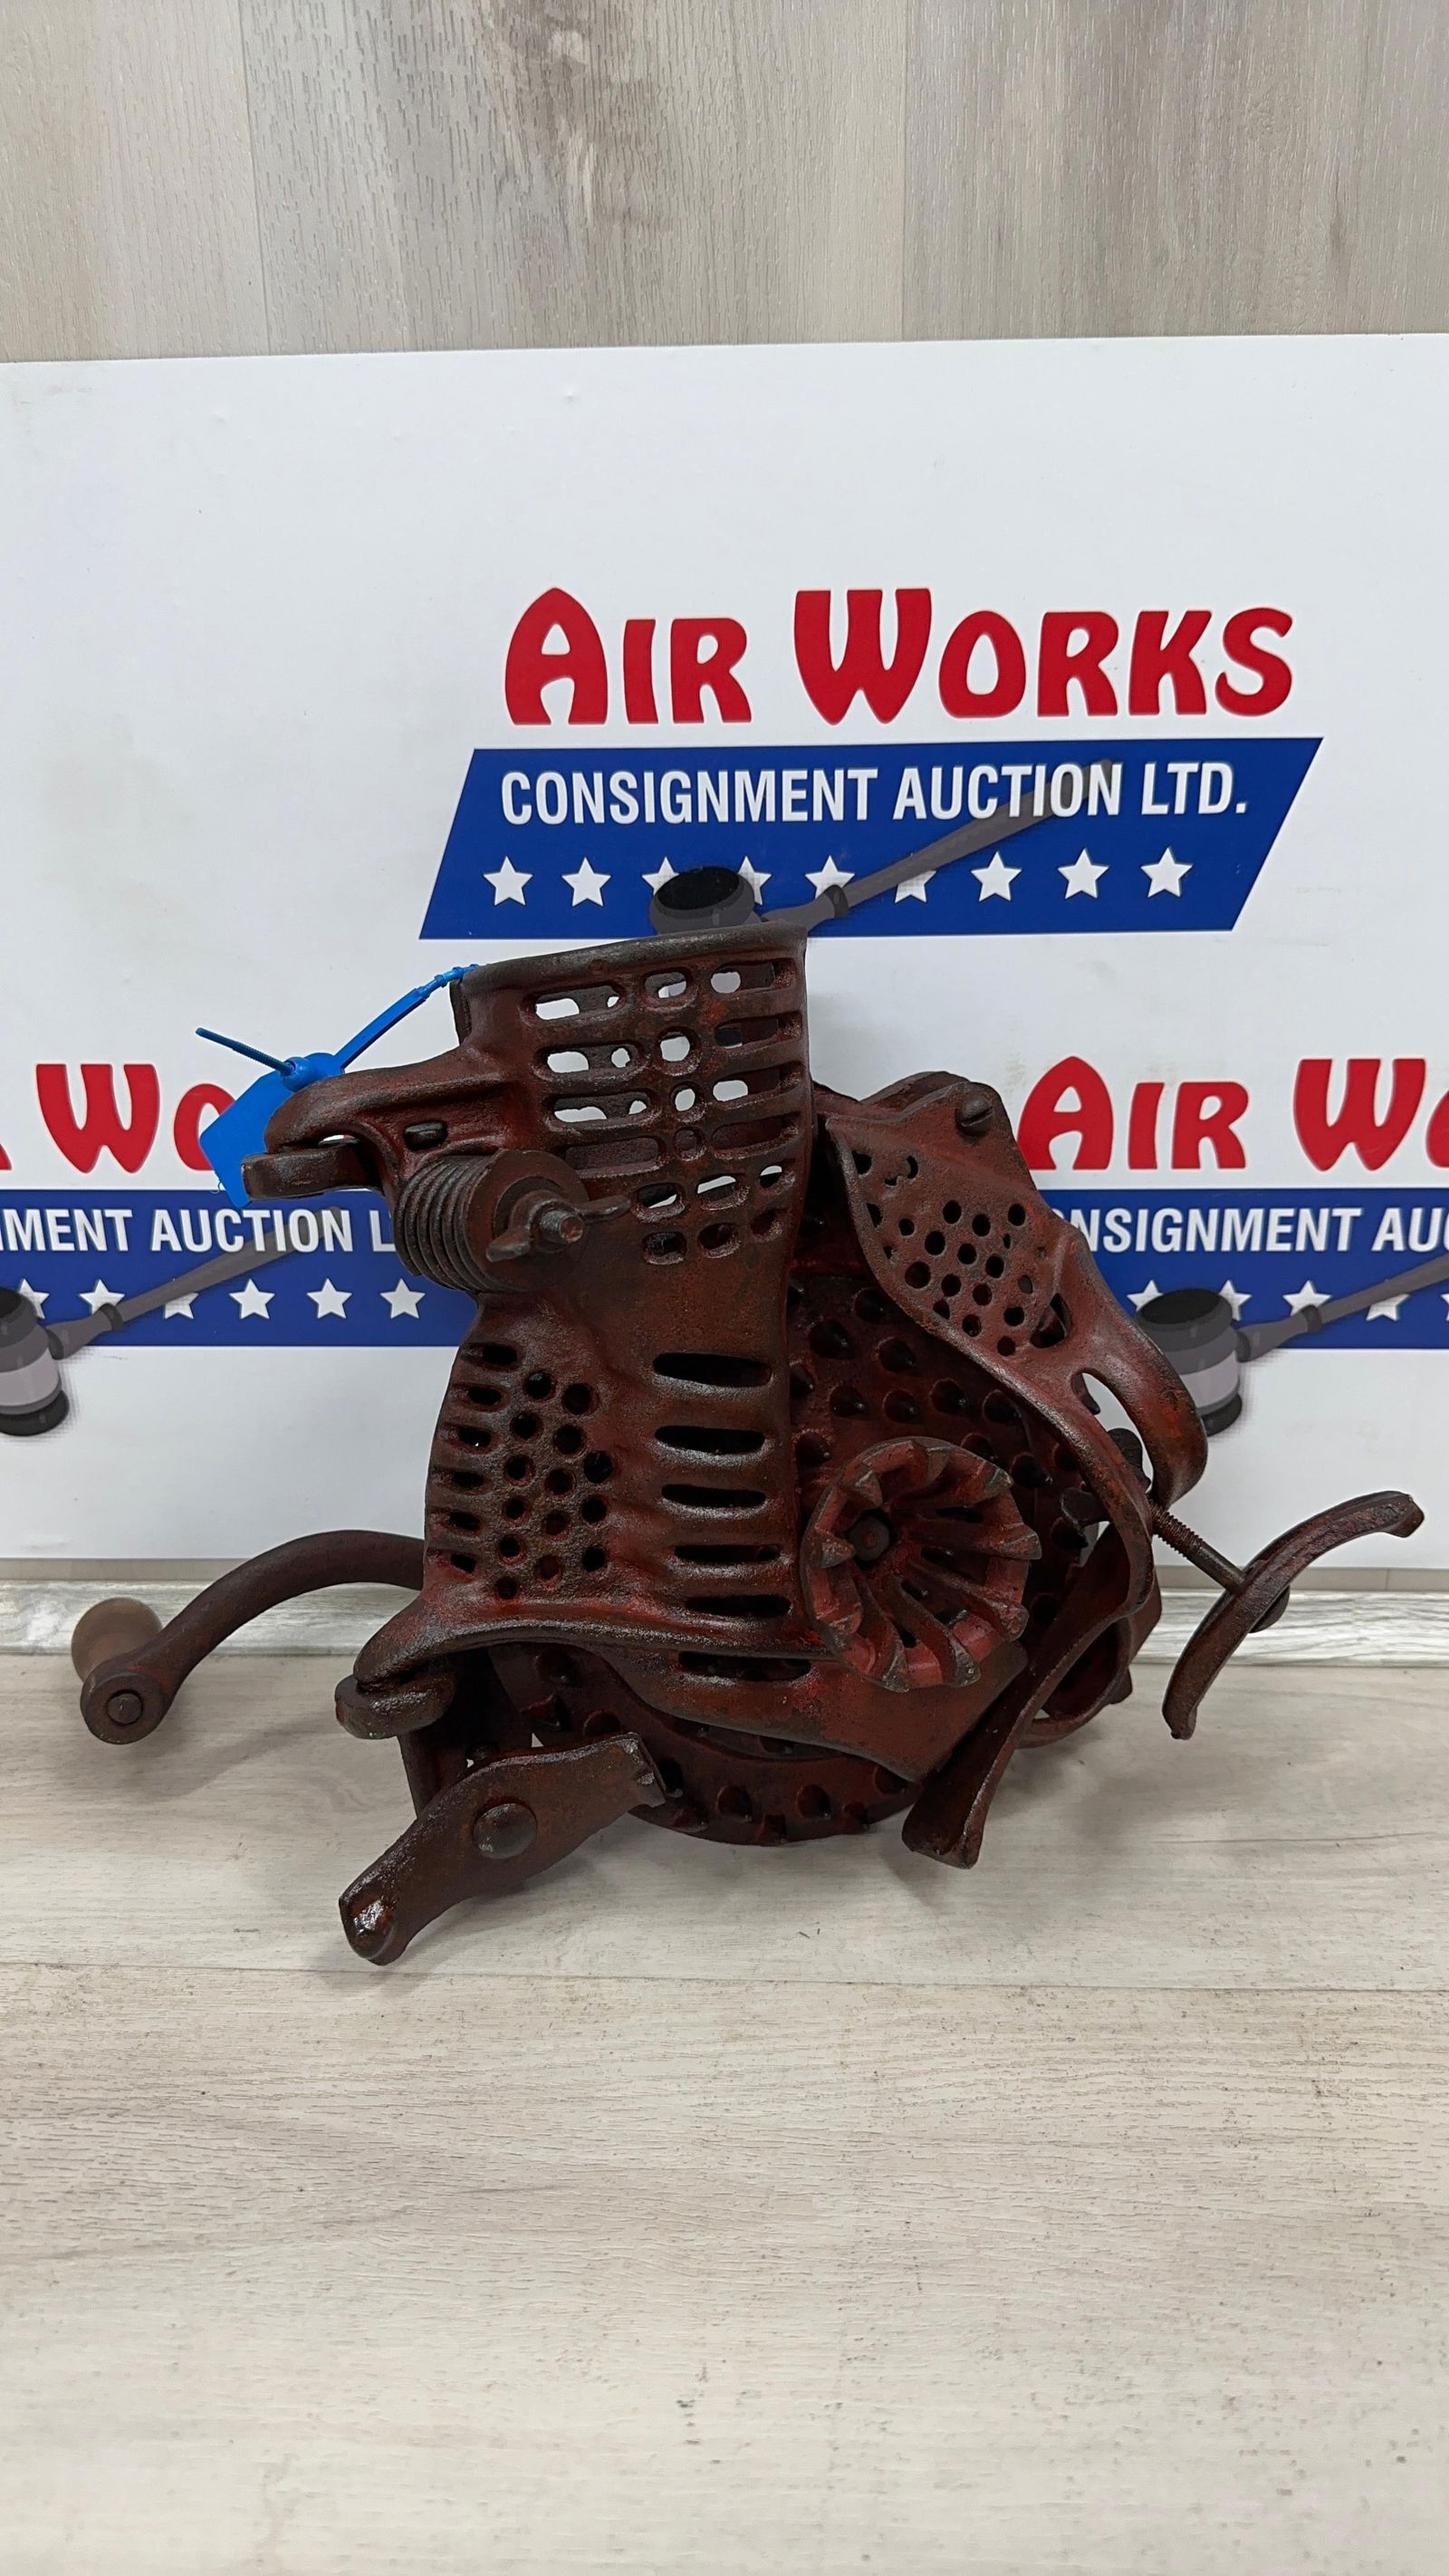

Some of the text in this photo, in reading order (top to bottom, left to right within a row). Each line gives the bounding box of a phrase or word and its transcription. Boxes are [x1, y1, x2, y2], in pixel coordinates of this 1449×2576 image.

[504, 587, 1294, 726] AIR WORKS
[500, 762, 1248, 825] CONSIGNMENT AUCTION LTD.
[1016, 1056, 1250, 1170] AIR
[0, 1208, 132, 1252] MENT
[151, 1208, 353, 1253] AUCTION
[1051, 1207, 1449, 1253] NSIGNMENT AU
